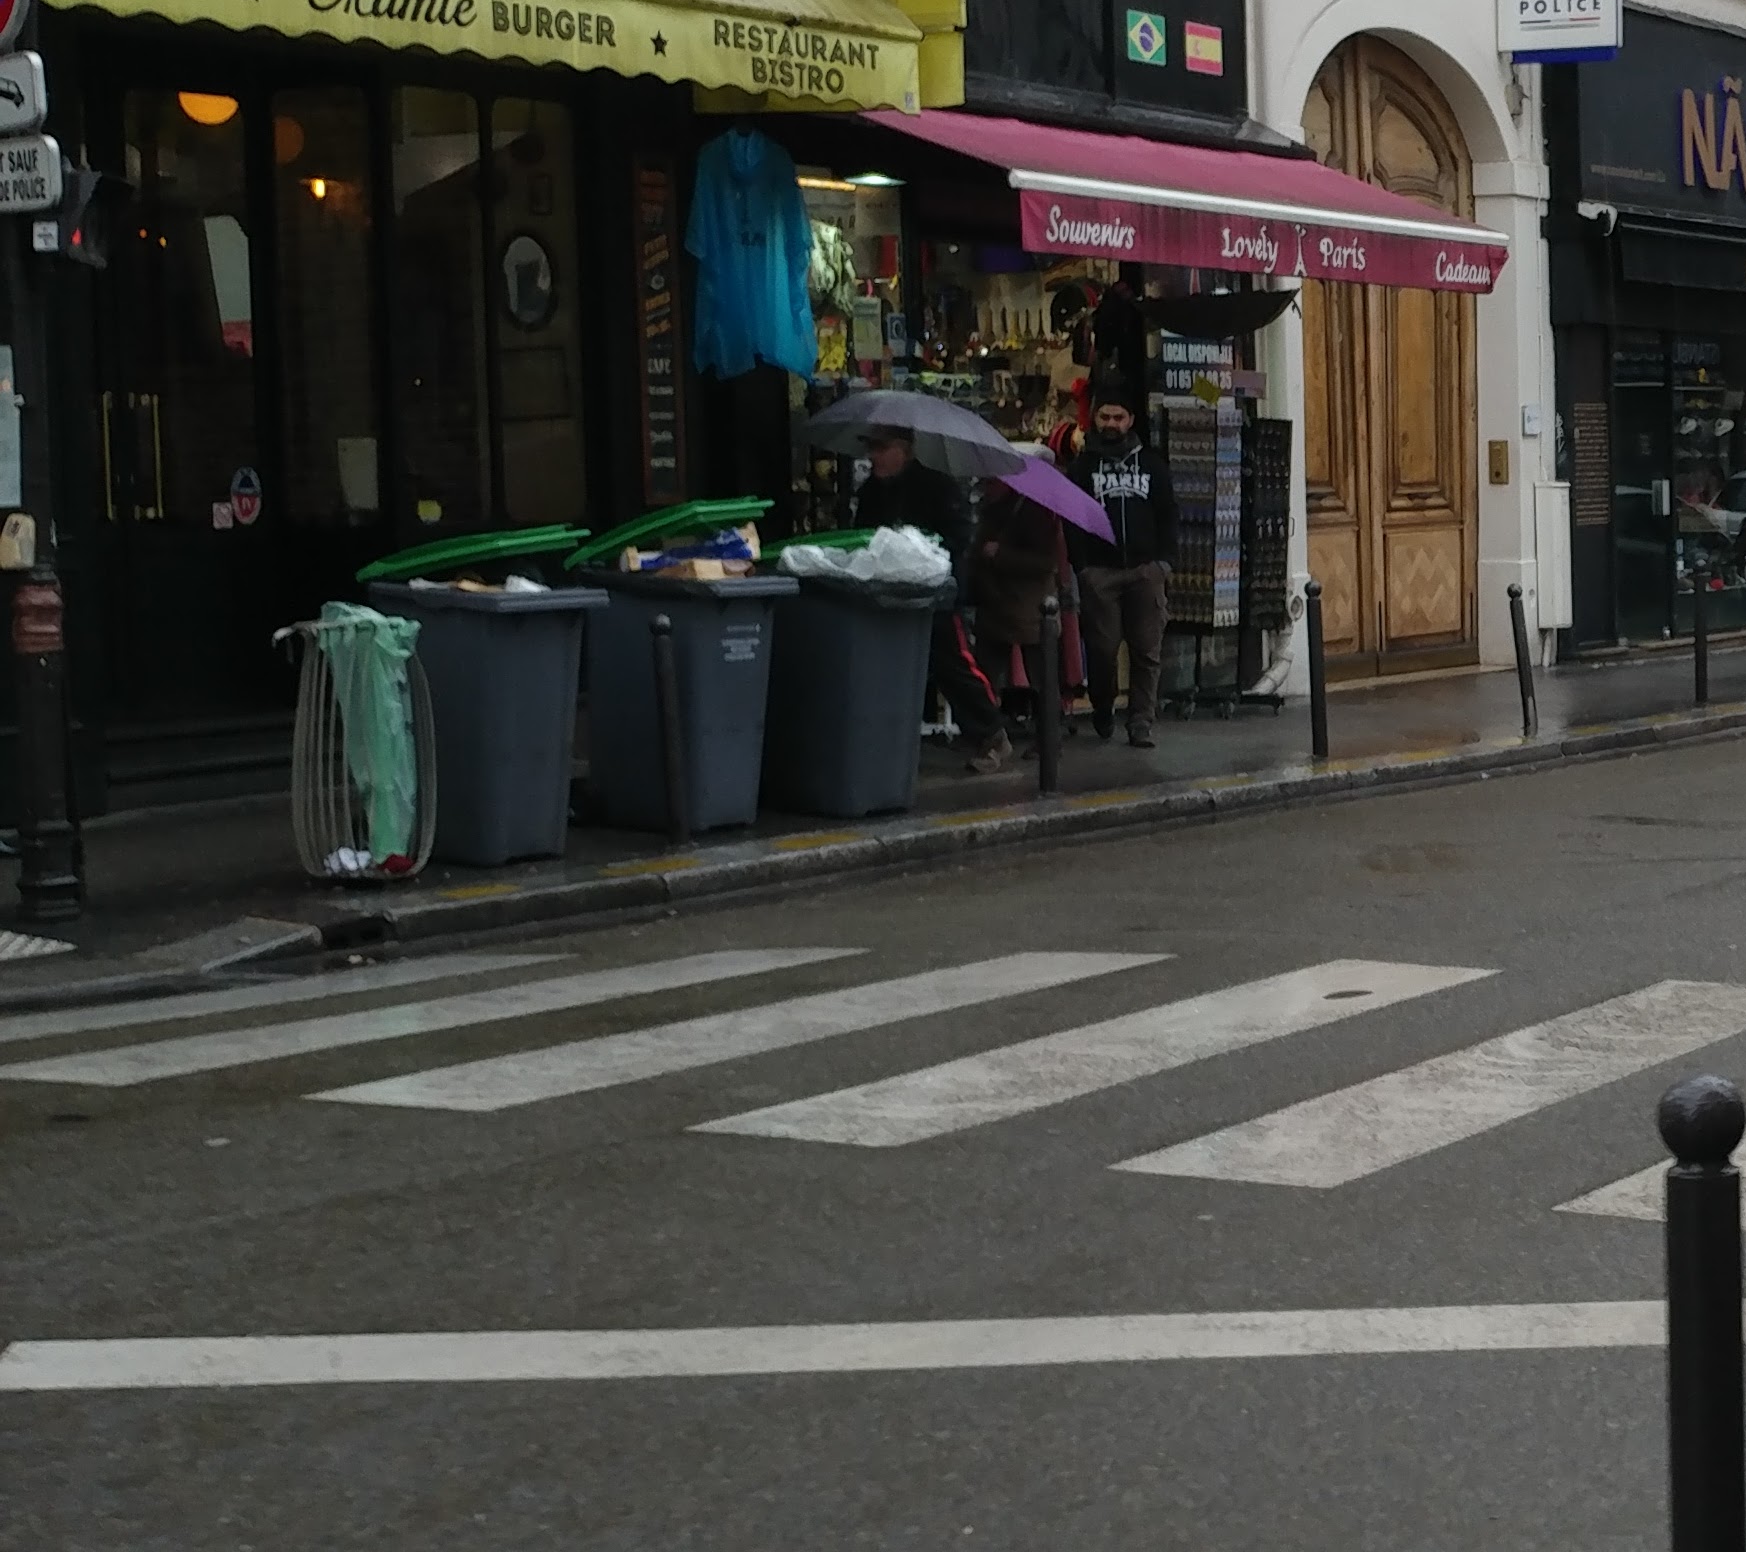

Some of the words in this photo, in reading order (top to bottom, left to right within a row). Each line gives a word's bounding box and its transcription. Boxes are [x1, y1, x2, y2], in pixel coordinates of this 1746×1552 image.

[491, 0, 617, 47] BURGER
[714, 19, 880, 70] RESTAURANT
[752, 56, 845, 94] BISTRO
[8, 148, 38, 173] SAUF
[12, 177, 46, 201] POLICE
[1046, 204, 1137, 250] Souvenirs
[1221, 225, 1279, 274] Lovely
[1319, 237, 1367, 271] Paris
[1091, 472, 1151, 499] PARIS
